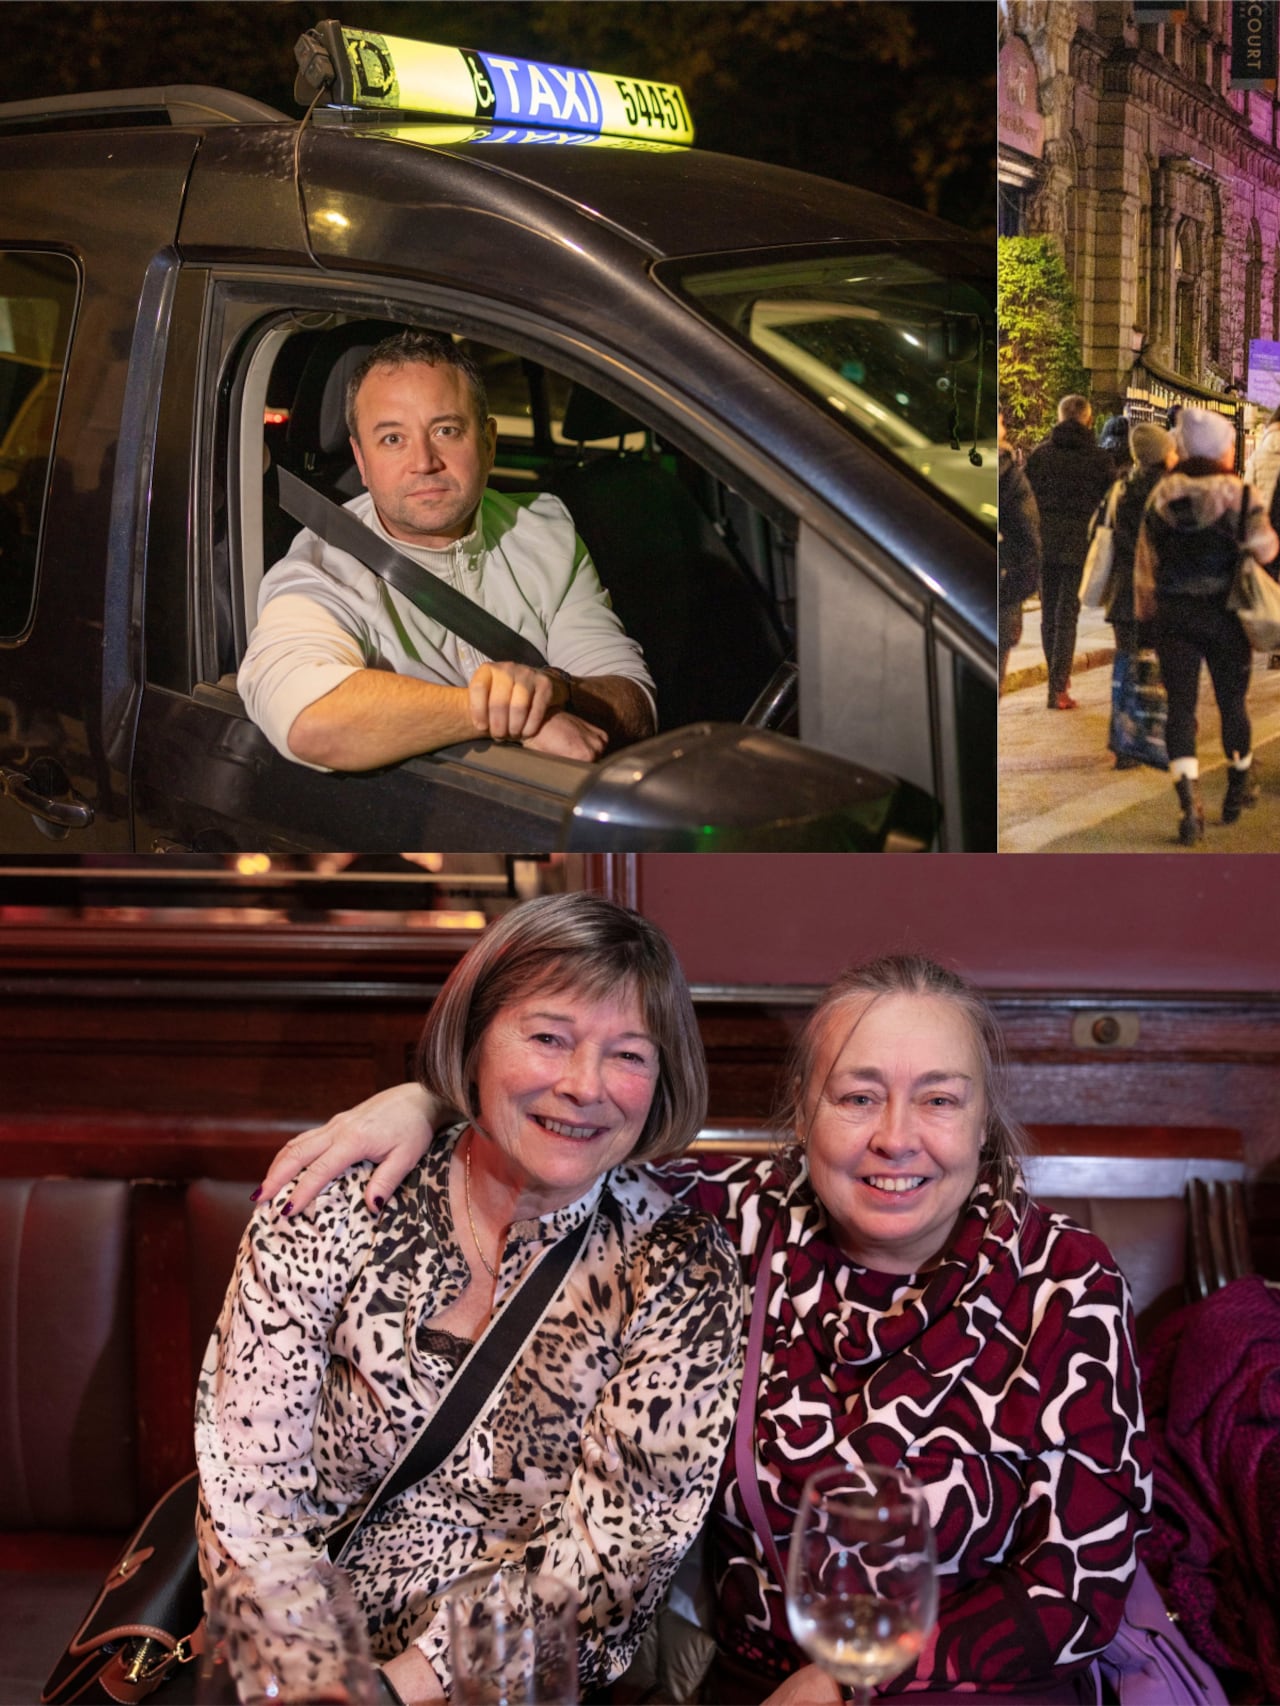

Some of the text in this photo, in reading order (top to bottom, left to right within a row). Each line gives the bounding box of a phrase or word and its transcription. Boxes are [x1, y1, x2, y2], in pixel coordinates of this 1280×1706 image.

[1247, 0, 1262, 69] COURT
[487, 57, 689, 132] TAXI 54451
